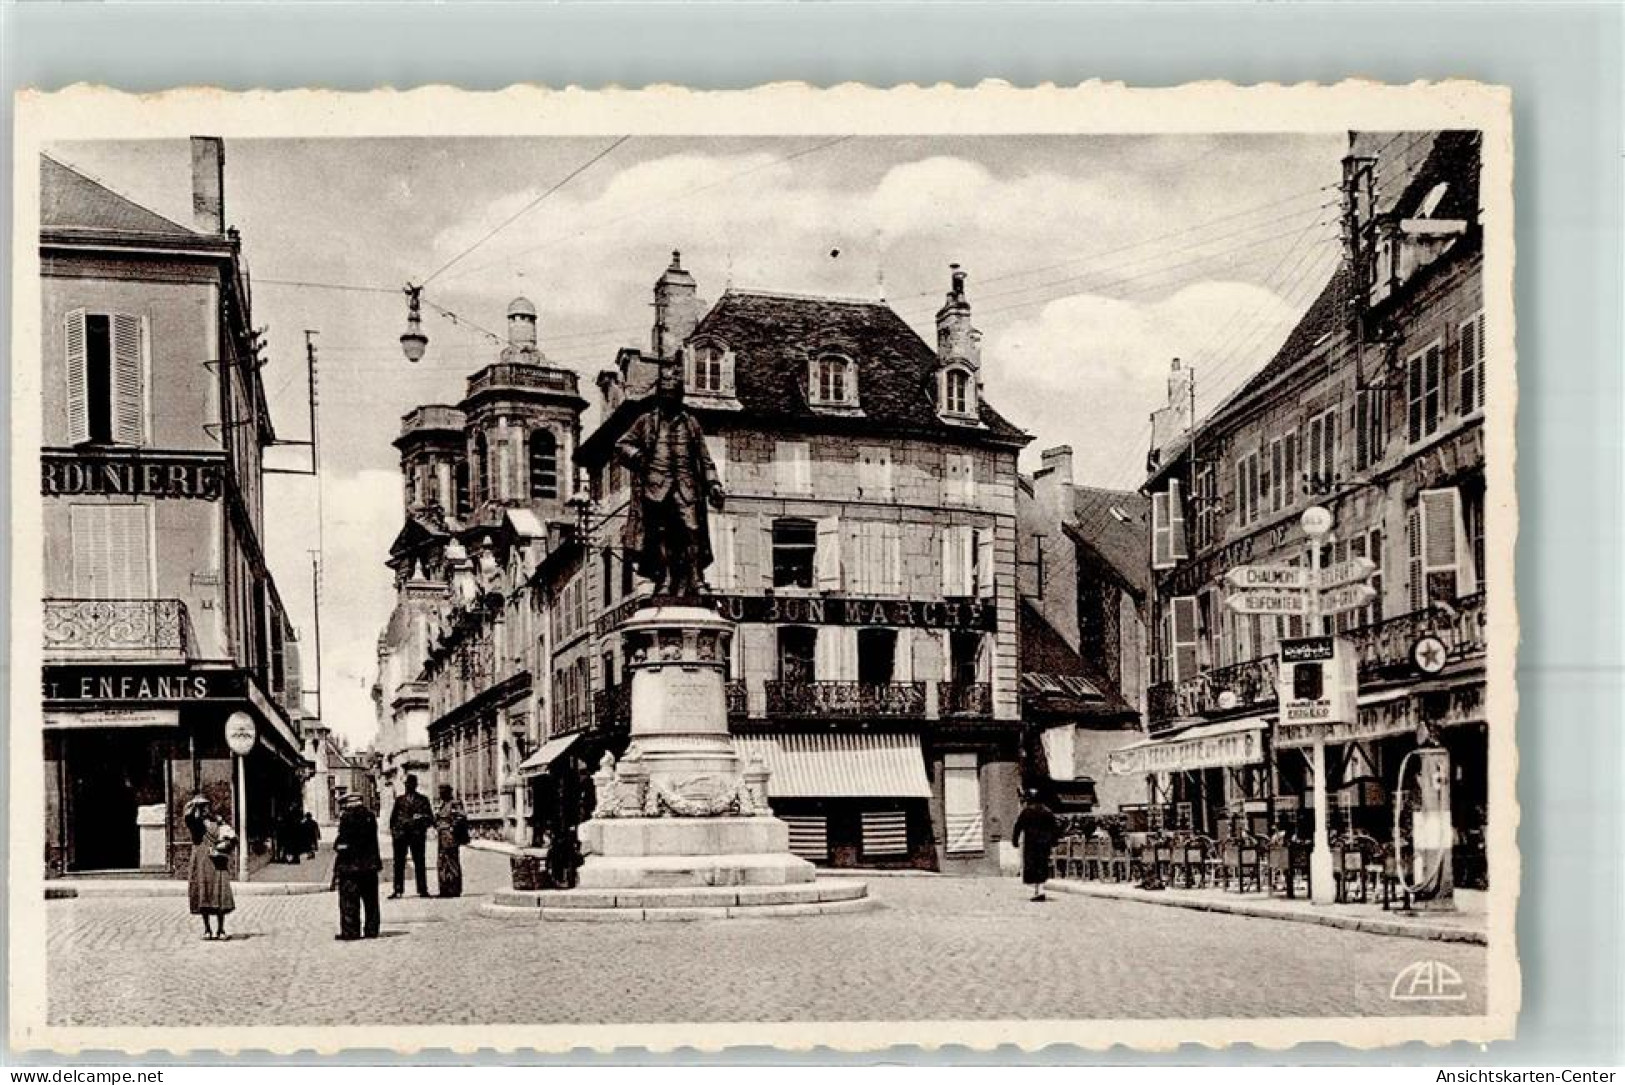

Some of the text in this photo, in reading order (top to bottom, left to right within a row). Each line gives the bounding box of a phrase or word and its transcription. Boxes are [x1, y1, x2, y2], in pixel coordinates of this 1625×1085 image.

[1246, 569, 1300, 583] CHAUMONT
[765, 598, 825, 622] BON
[81, 677, 208, 698] ENFANTS
